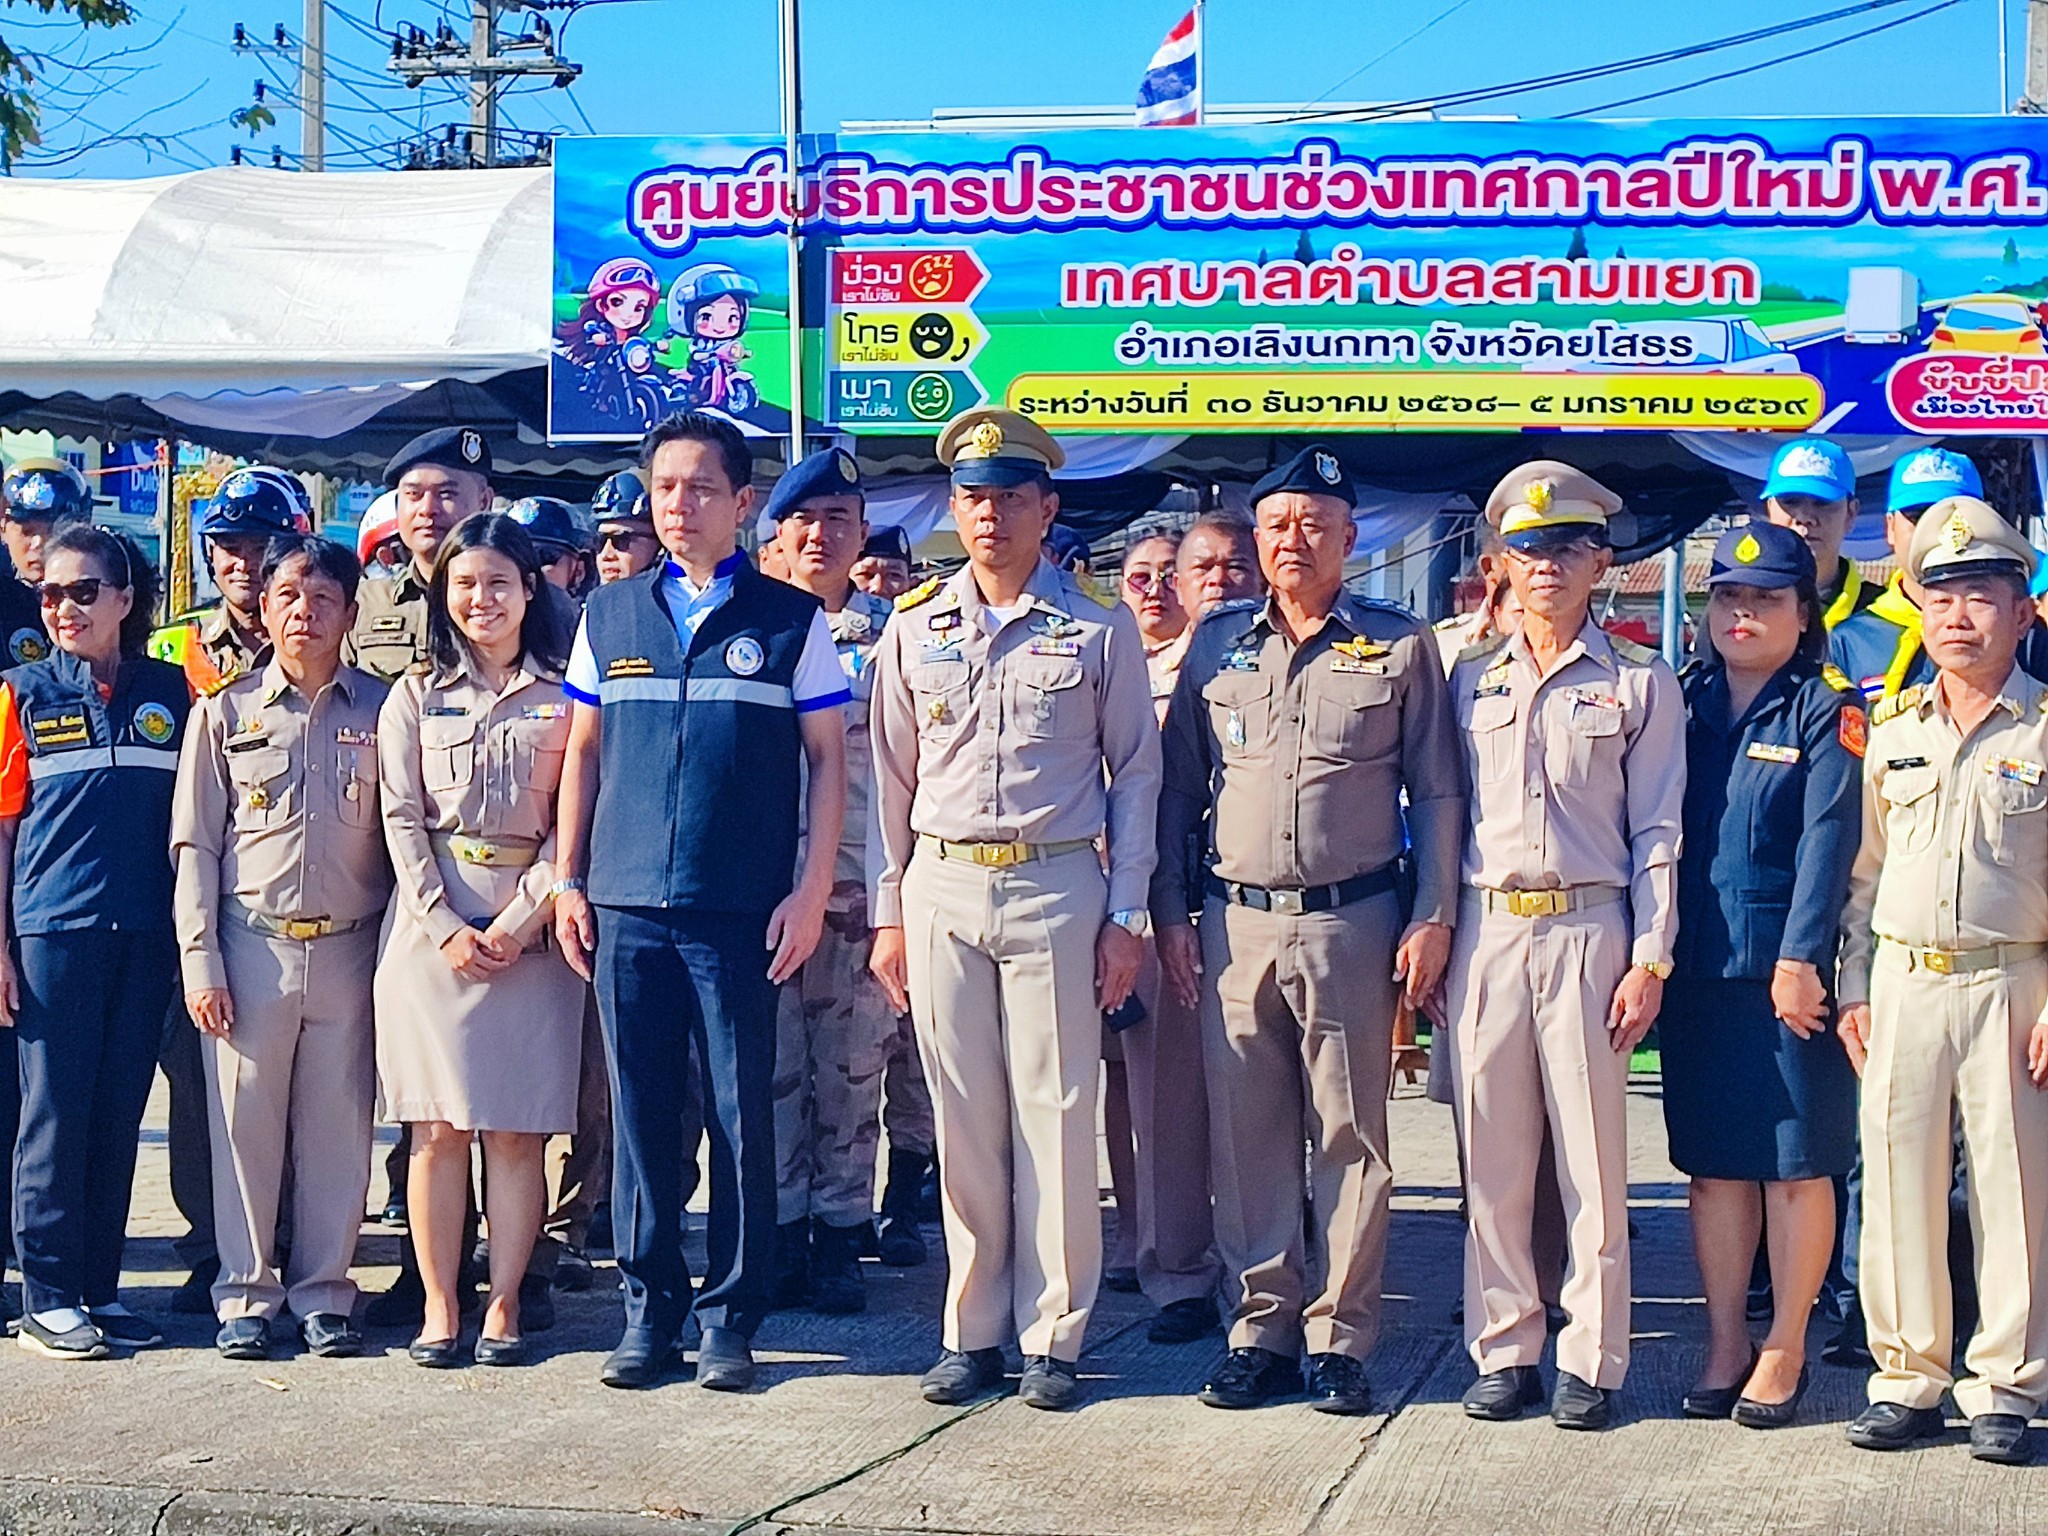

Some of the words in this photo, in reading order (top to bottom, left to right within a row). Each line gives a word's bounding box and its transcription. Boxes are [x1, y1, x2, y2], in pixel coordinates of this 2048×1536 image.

[1879, 164, 2041, 207] พ.ศ.
[843, 254, 902, 284] ง่วง
[1066, 248, 1755, 301] เทศบาลตำบลสามแยก
[844, 312, 898, 343] โทร
[1120, 326, 1415, 358] อำเภอเลิงนกทา
[1429, 325, 1694, 357] จังหวัดยโสธร
[841, 378, 891, 399] เมา
[1924, 355, 2048, 391] ขับขี่ป
[1018, 382, 1189, 414] ระหว่างวันที่
[1206, 397, 1252, 414] ๓๐
[1263, 390, 1388, 413] ธันวาคม
[1563, 396, 1693, 414] มกราคม
[1704, 396, 1809, 415] ๒๕๖๙
